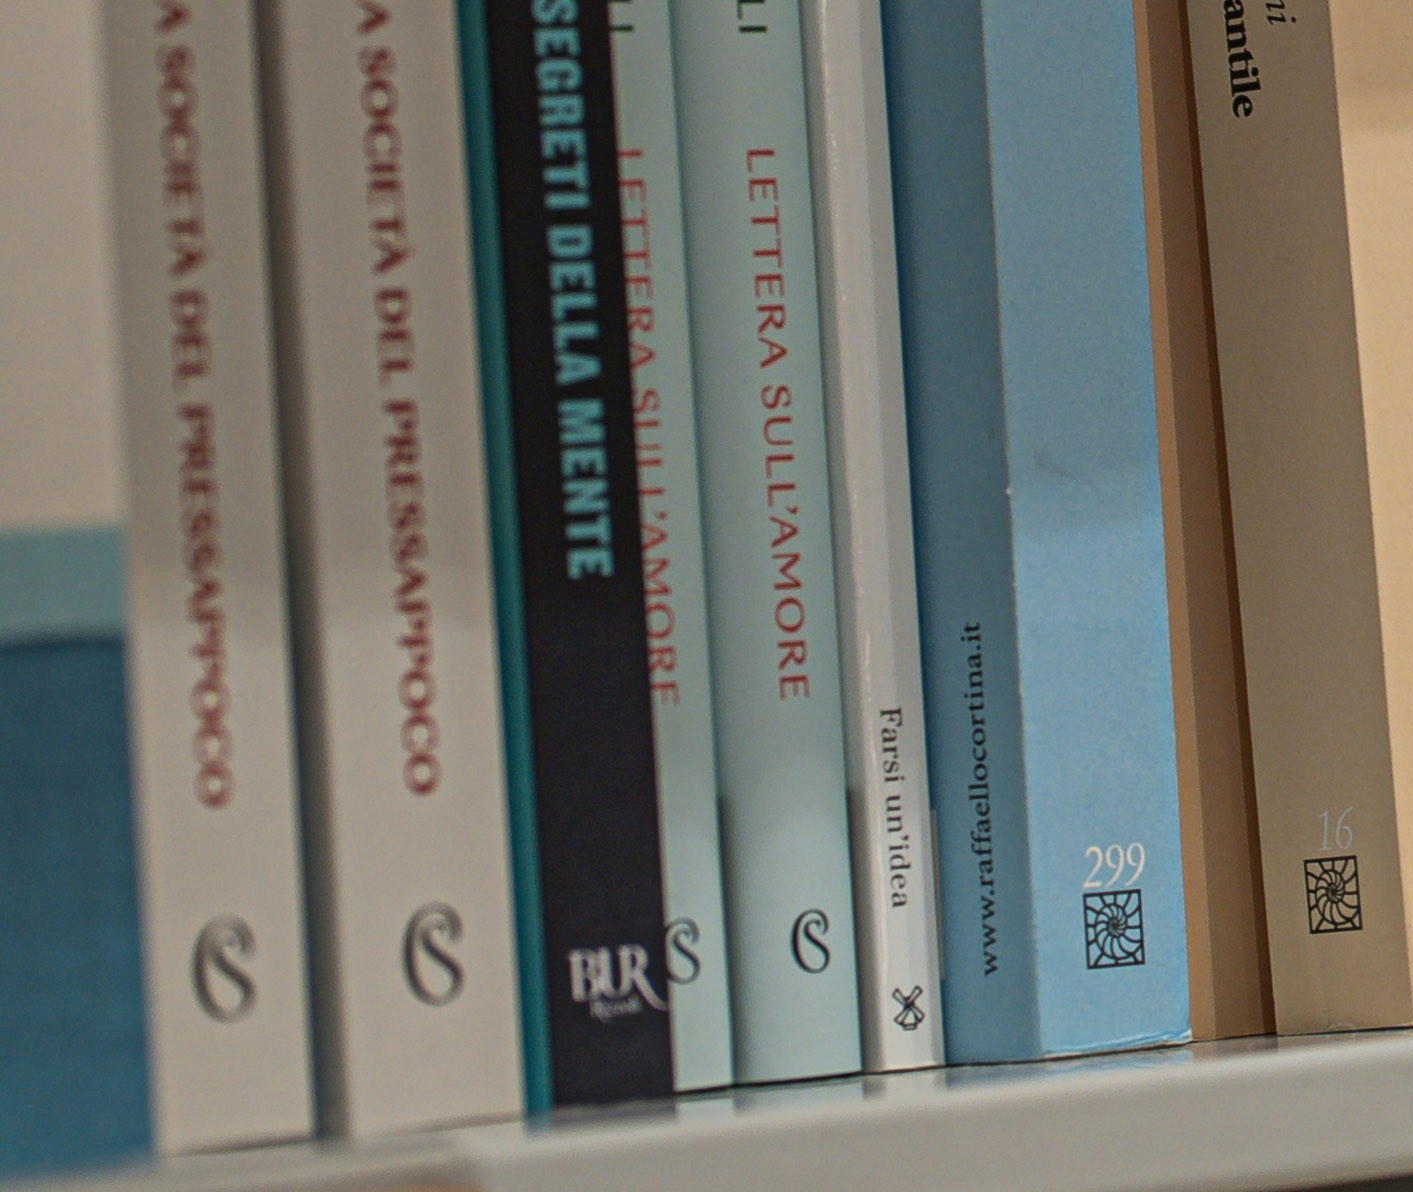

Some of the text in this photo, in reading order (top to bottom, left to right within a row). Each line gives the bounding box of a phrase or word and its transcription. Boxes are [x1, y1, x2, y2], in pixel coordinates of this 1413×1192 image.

[155, 44, 212, 276] SOCIETÀ
[357, 46, 414, 275] SOCIETÀ
[170, 290, 212, 391] DEL
[374, 288, 416, 384] DEL
[544, 221, 599, 381] DELLA
[745, 147, 788, 370] LETTERA
[557, 397, 613, 579] MENTE
[176, 406, 235, 808] PRESSAPPOCO
[381, 400, 442, 797] PRESSAPPOCO
[879, 706, 905, 782] Farsi
[962, 620, 999, 977] www.raffaellocortina.it
[1317, 806, 1354, 852] 16
[1082, 842, 1147, 889] 299
[569, 944, 668, 1012] BUR
